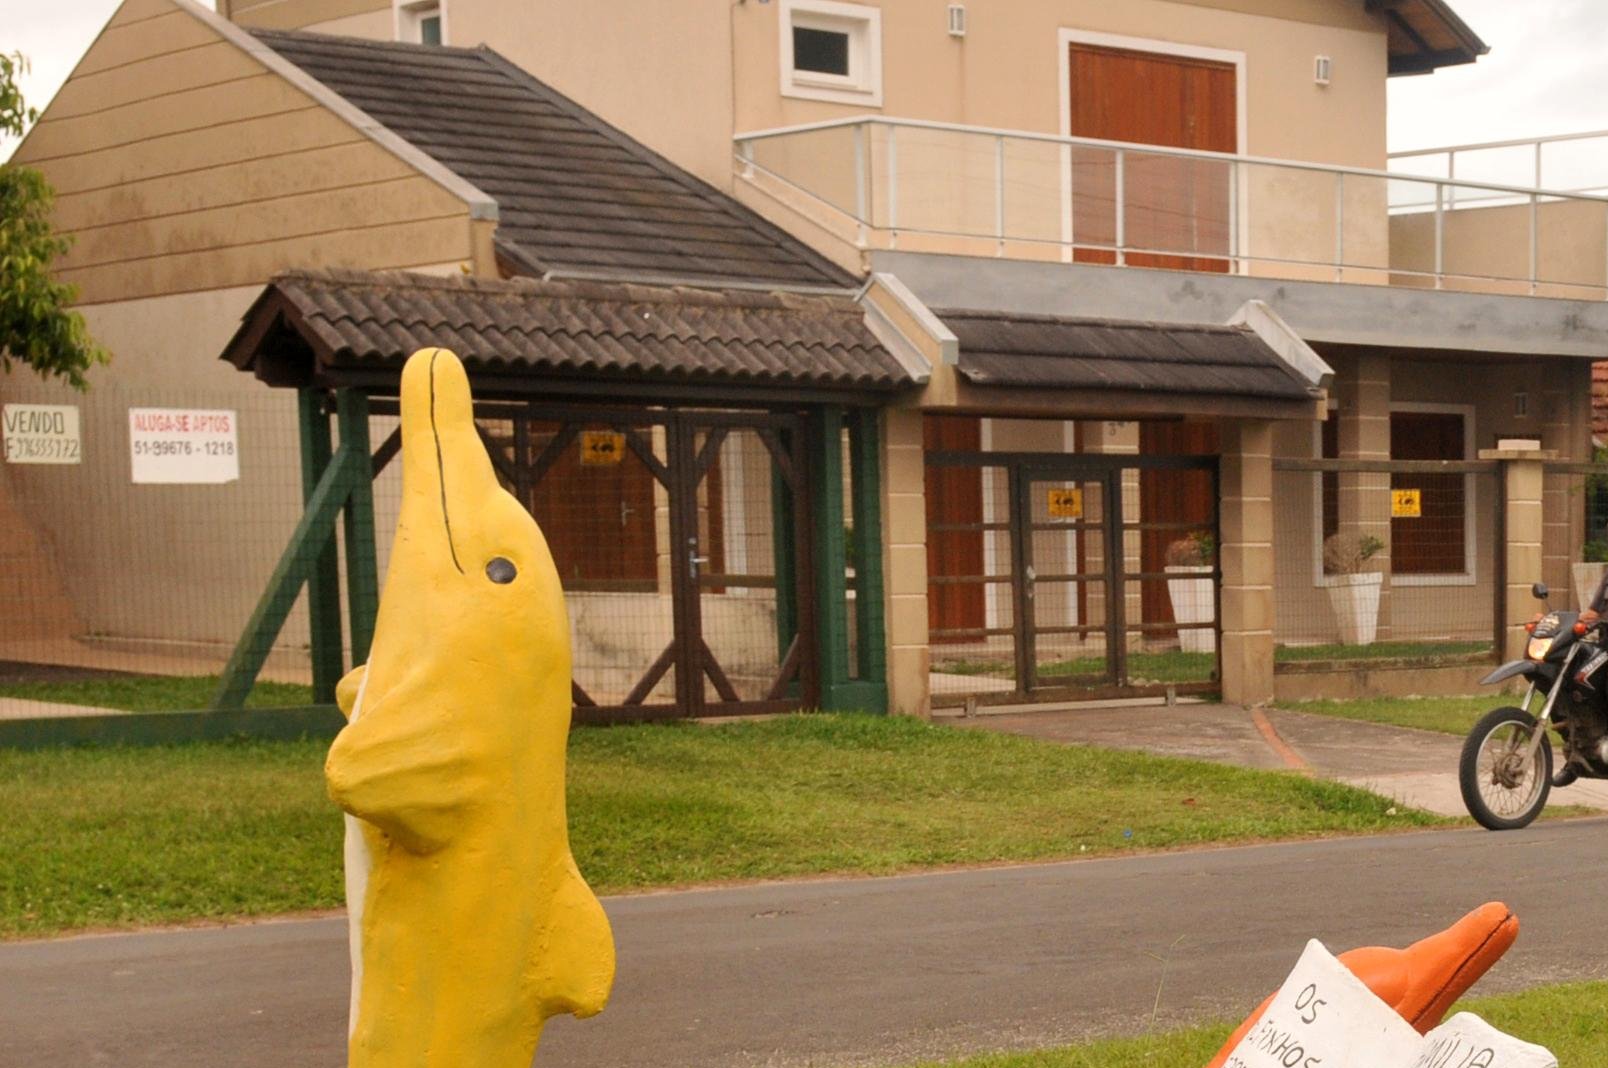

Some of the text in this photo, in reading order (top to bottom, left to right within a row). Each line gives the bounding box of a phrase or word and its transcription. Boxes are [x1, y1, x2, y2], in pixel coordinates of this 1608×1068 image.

[4, 409, 64, 434] VENDO
[134, 414, 230, 433] ALUGA-SE APTOS
[204, 441, 234, 455] 1218
[1295, 983, 1328, 1025] OS
